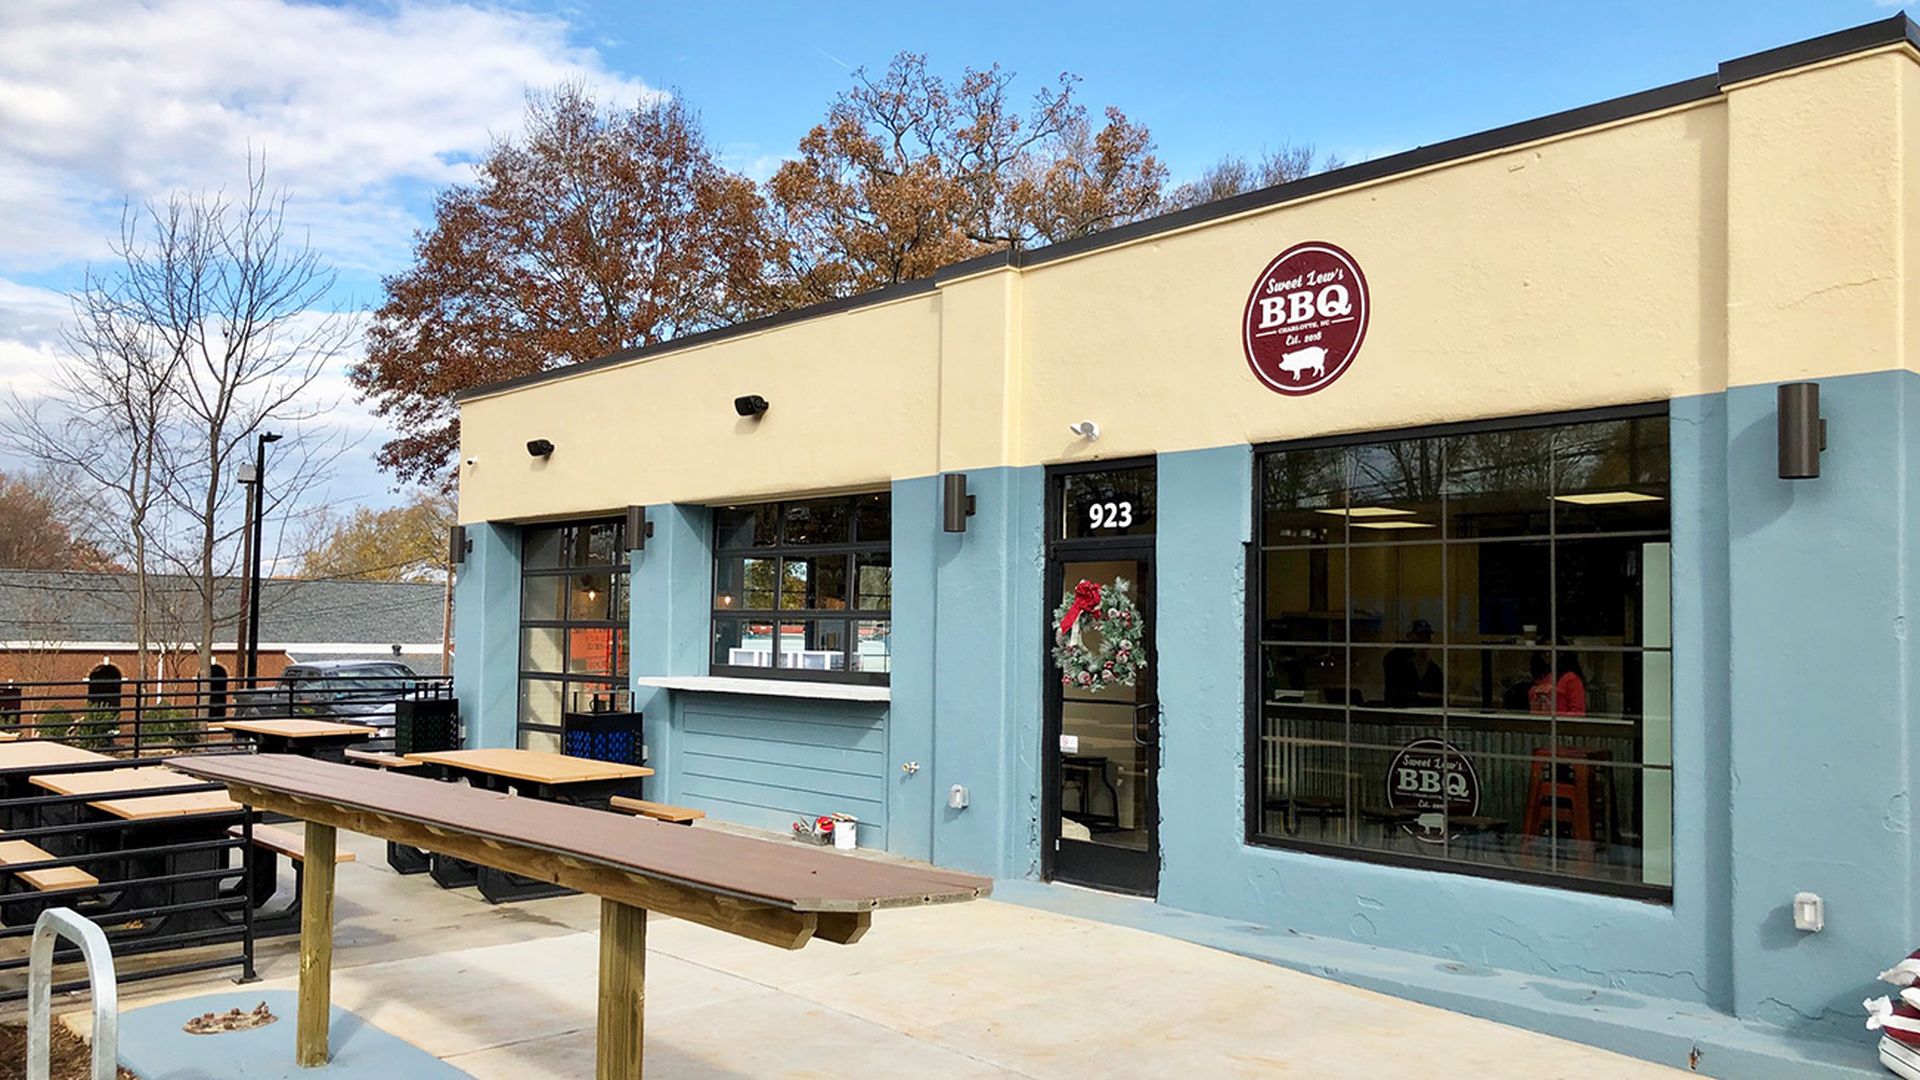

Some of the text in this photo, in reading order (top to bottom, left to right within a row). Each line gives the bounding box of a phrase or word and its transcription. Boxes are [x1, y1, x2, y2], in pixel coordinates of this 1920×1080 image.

[1266, 268, 1344, 294] Sweet Lew's
[1258, 284, 1352, 329] BBQ
[1089, 501, 1132, 529] 923
[1402, 754, 1431, 767] Sweet
[1396, 768, 1469, 797] BBQ
